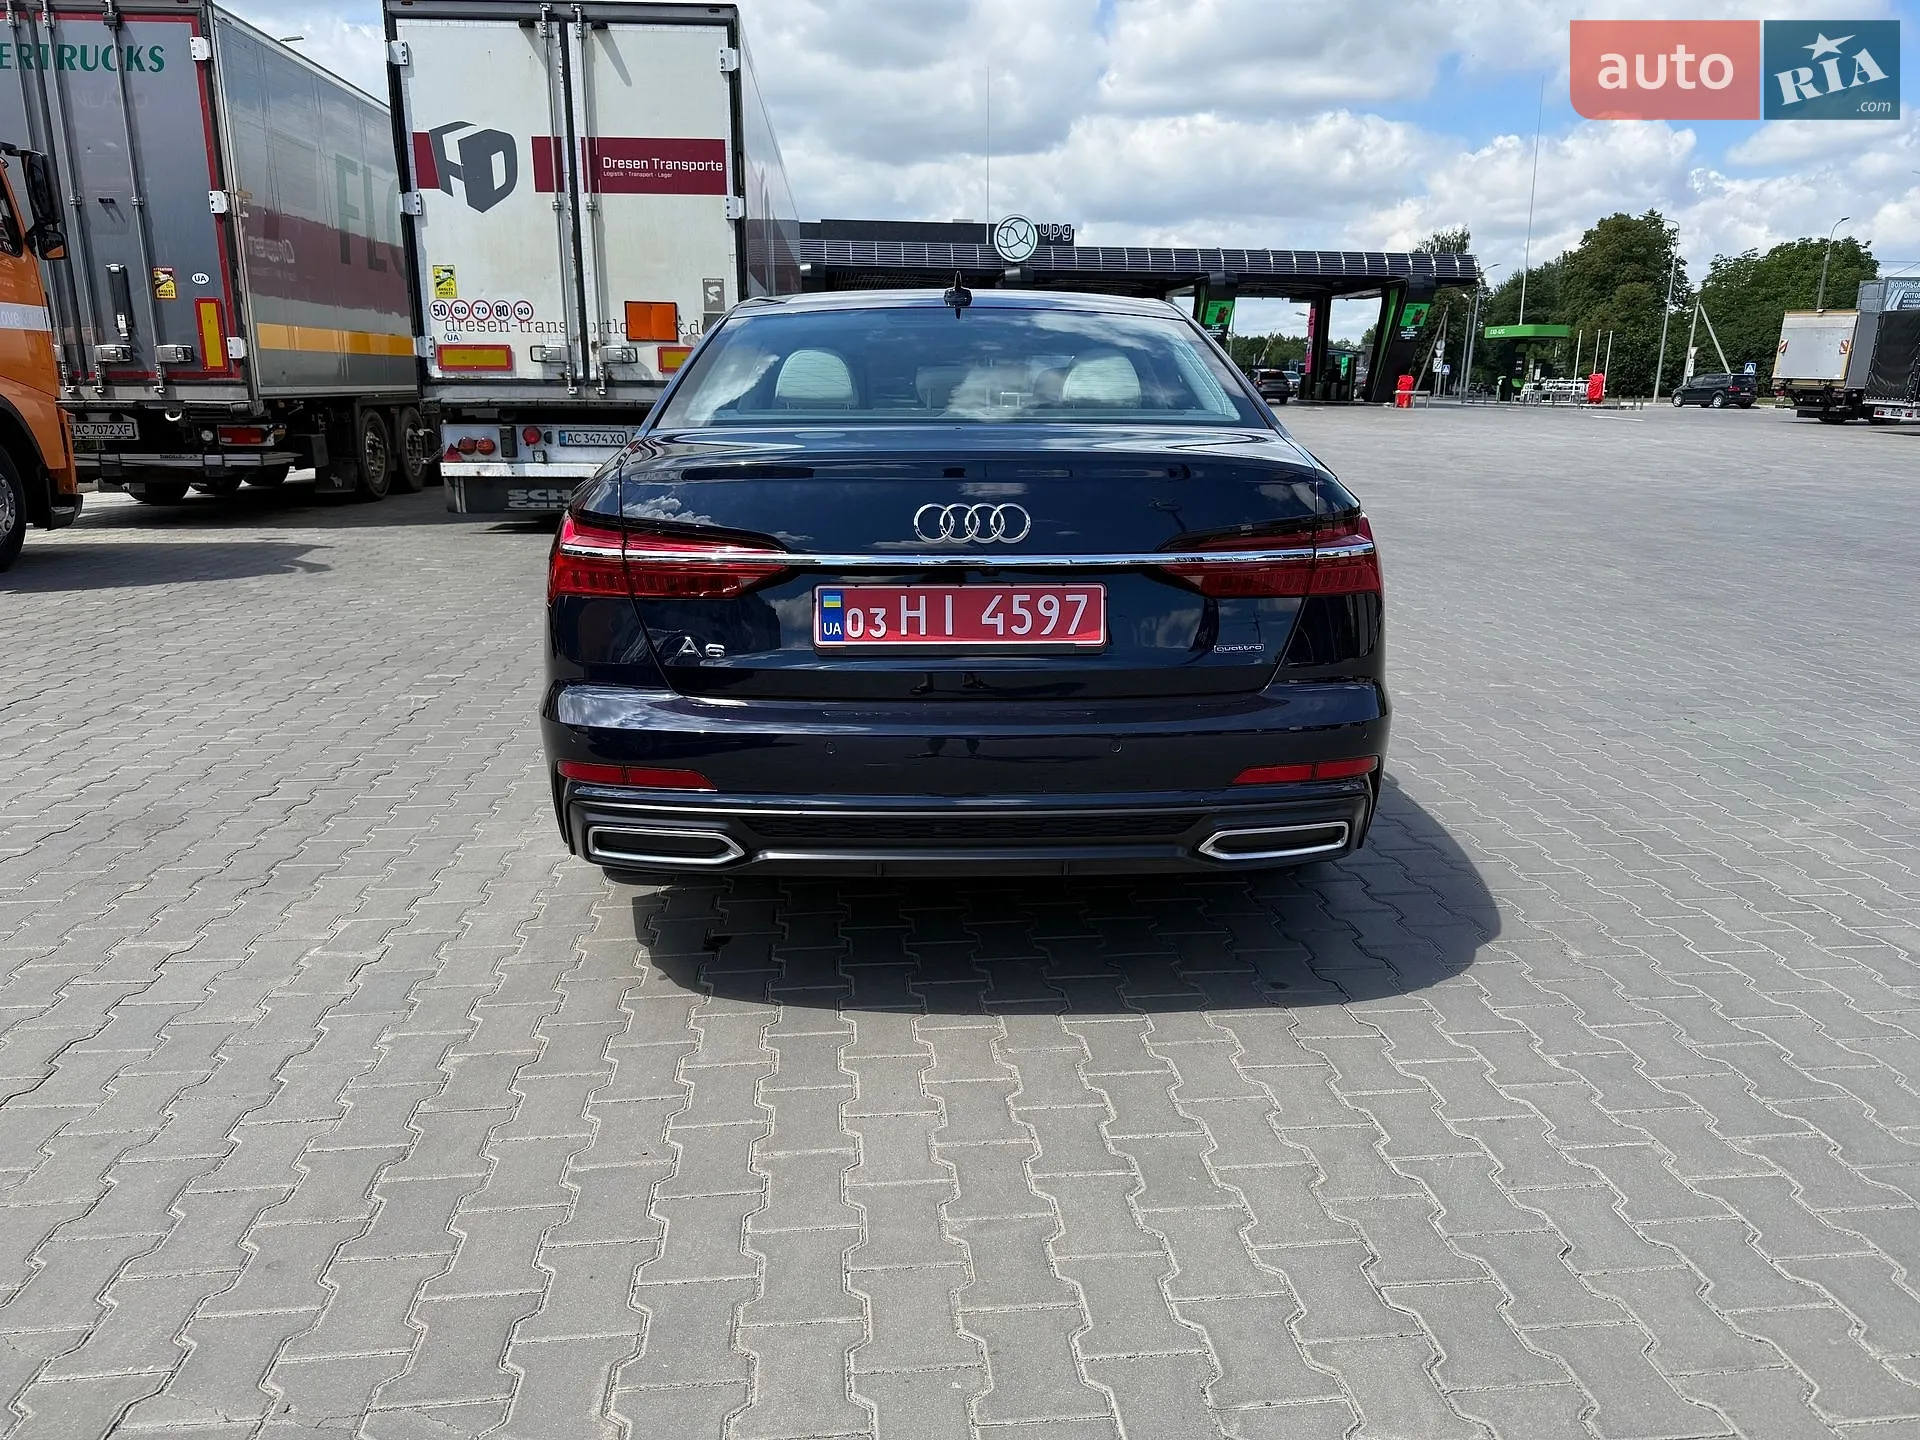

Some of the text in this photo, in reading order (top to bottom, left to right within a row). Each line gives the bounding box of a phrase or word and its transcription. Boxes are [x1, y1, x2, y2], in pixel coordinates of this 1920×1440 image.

[602, 157, 724, 173] Dresen Transporte
[1040, 223, 1073, 242] upg
[432, 304, 529, 317] 50 60 70 80 90
[75, 425, 89, 435] AC
[91, 425, 115, 435] 7072
[567, 433, 625, 444] AC 3474 XO
[846, 594, 1089, 638] 03 HI 4597
[823, 623, 842, 636] UA
[676, 636, 725, 658] A6
[1215, 645, 1263, 653] quattro
